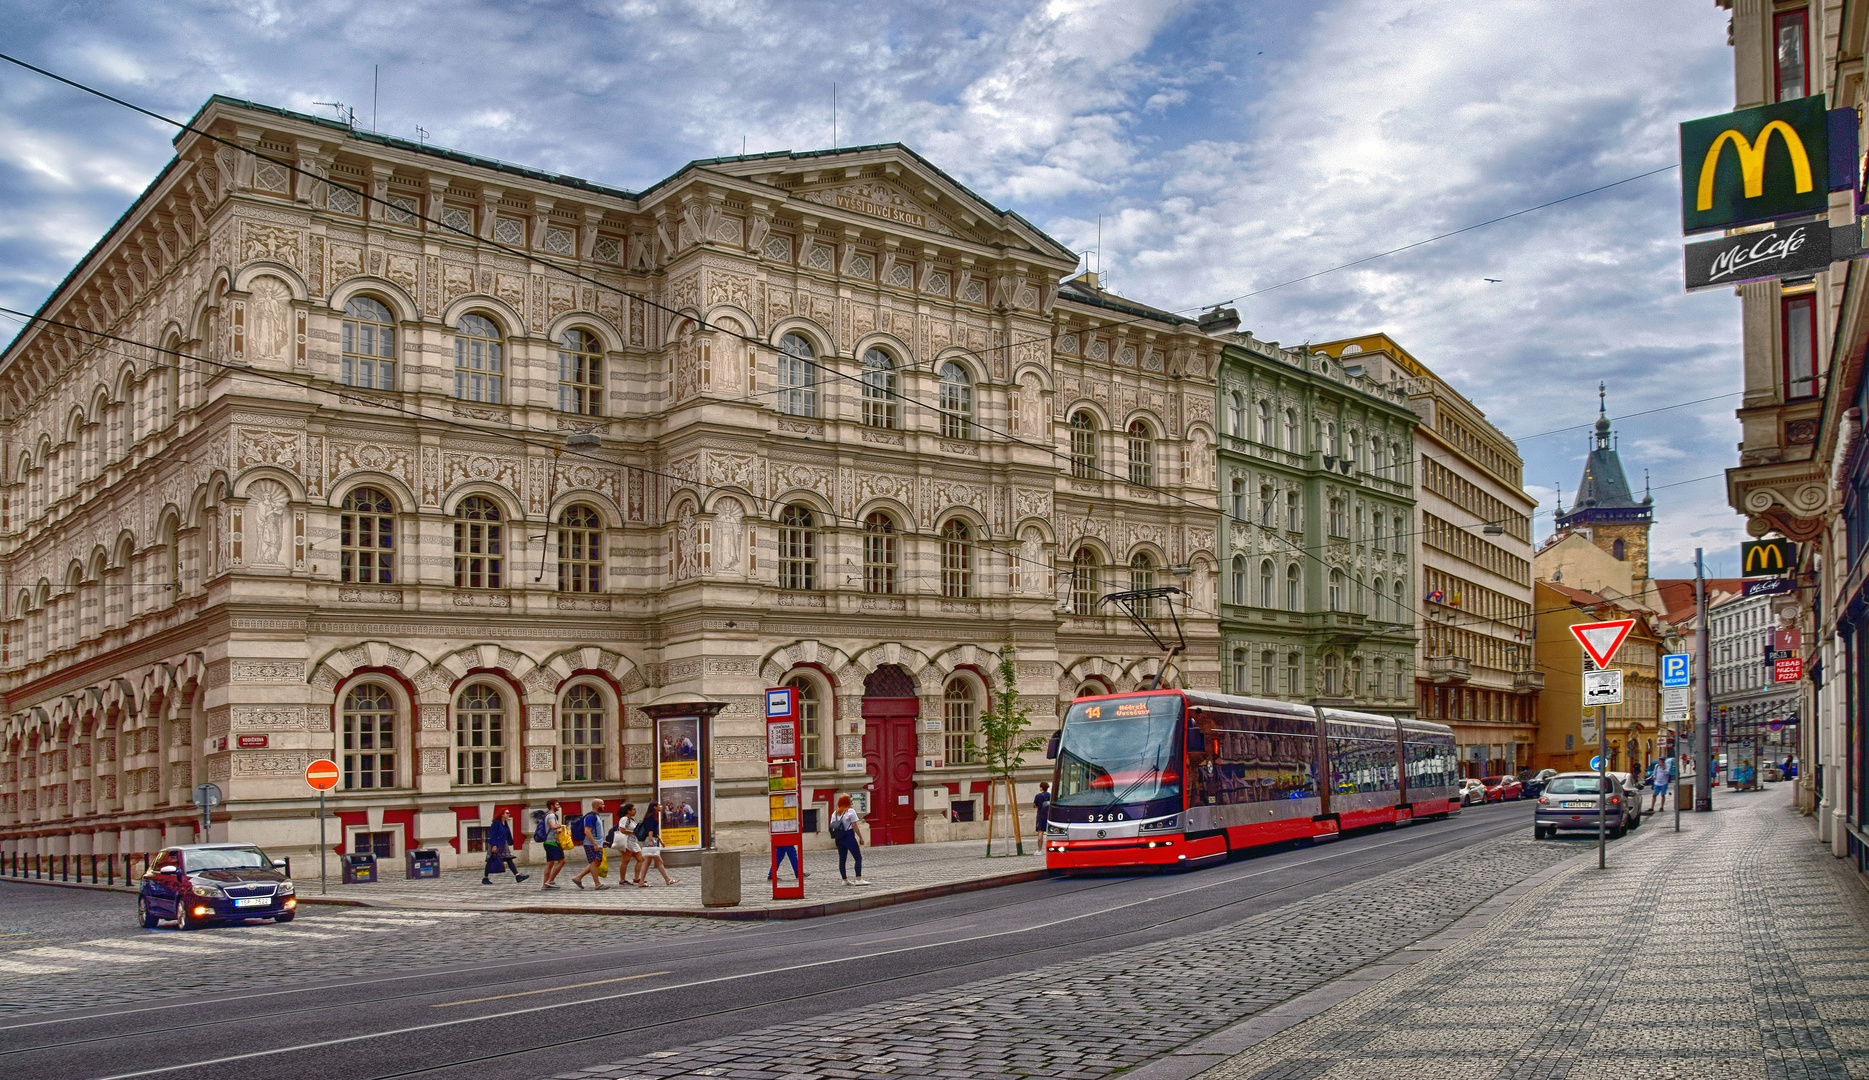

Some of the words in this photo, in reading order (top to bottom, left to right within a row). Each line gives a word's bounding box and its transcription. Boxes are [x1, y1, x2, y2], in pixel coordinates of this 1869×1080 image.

[893, 208, 922, 226] ŠKOLA
[1709, 227, 1806, 279] McCafé
[1668, 658, 1684, 677] P
[1778, 672, 1798, 680] PIZZA
[1085, 706, 1101, 719] 14
[1088, 813, 1124, 823] 9260
